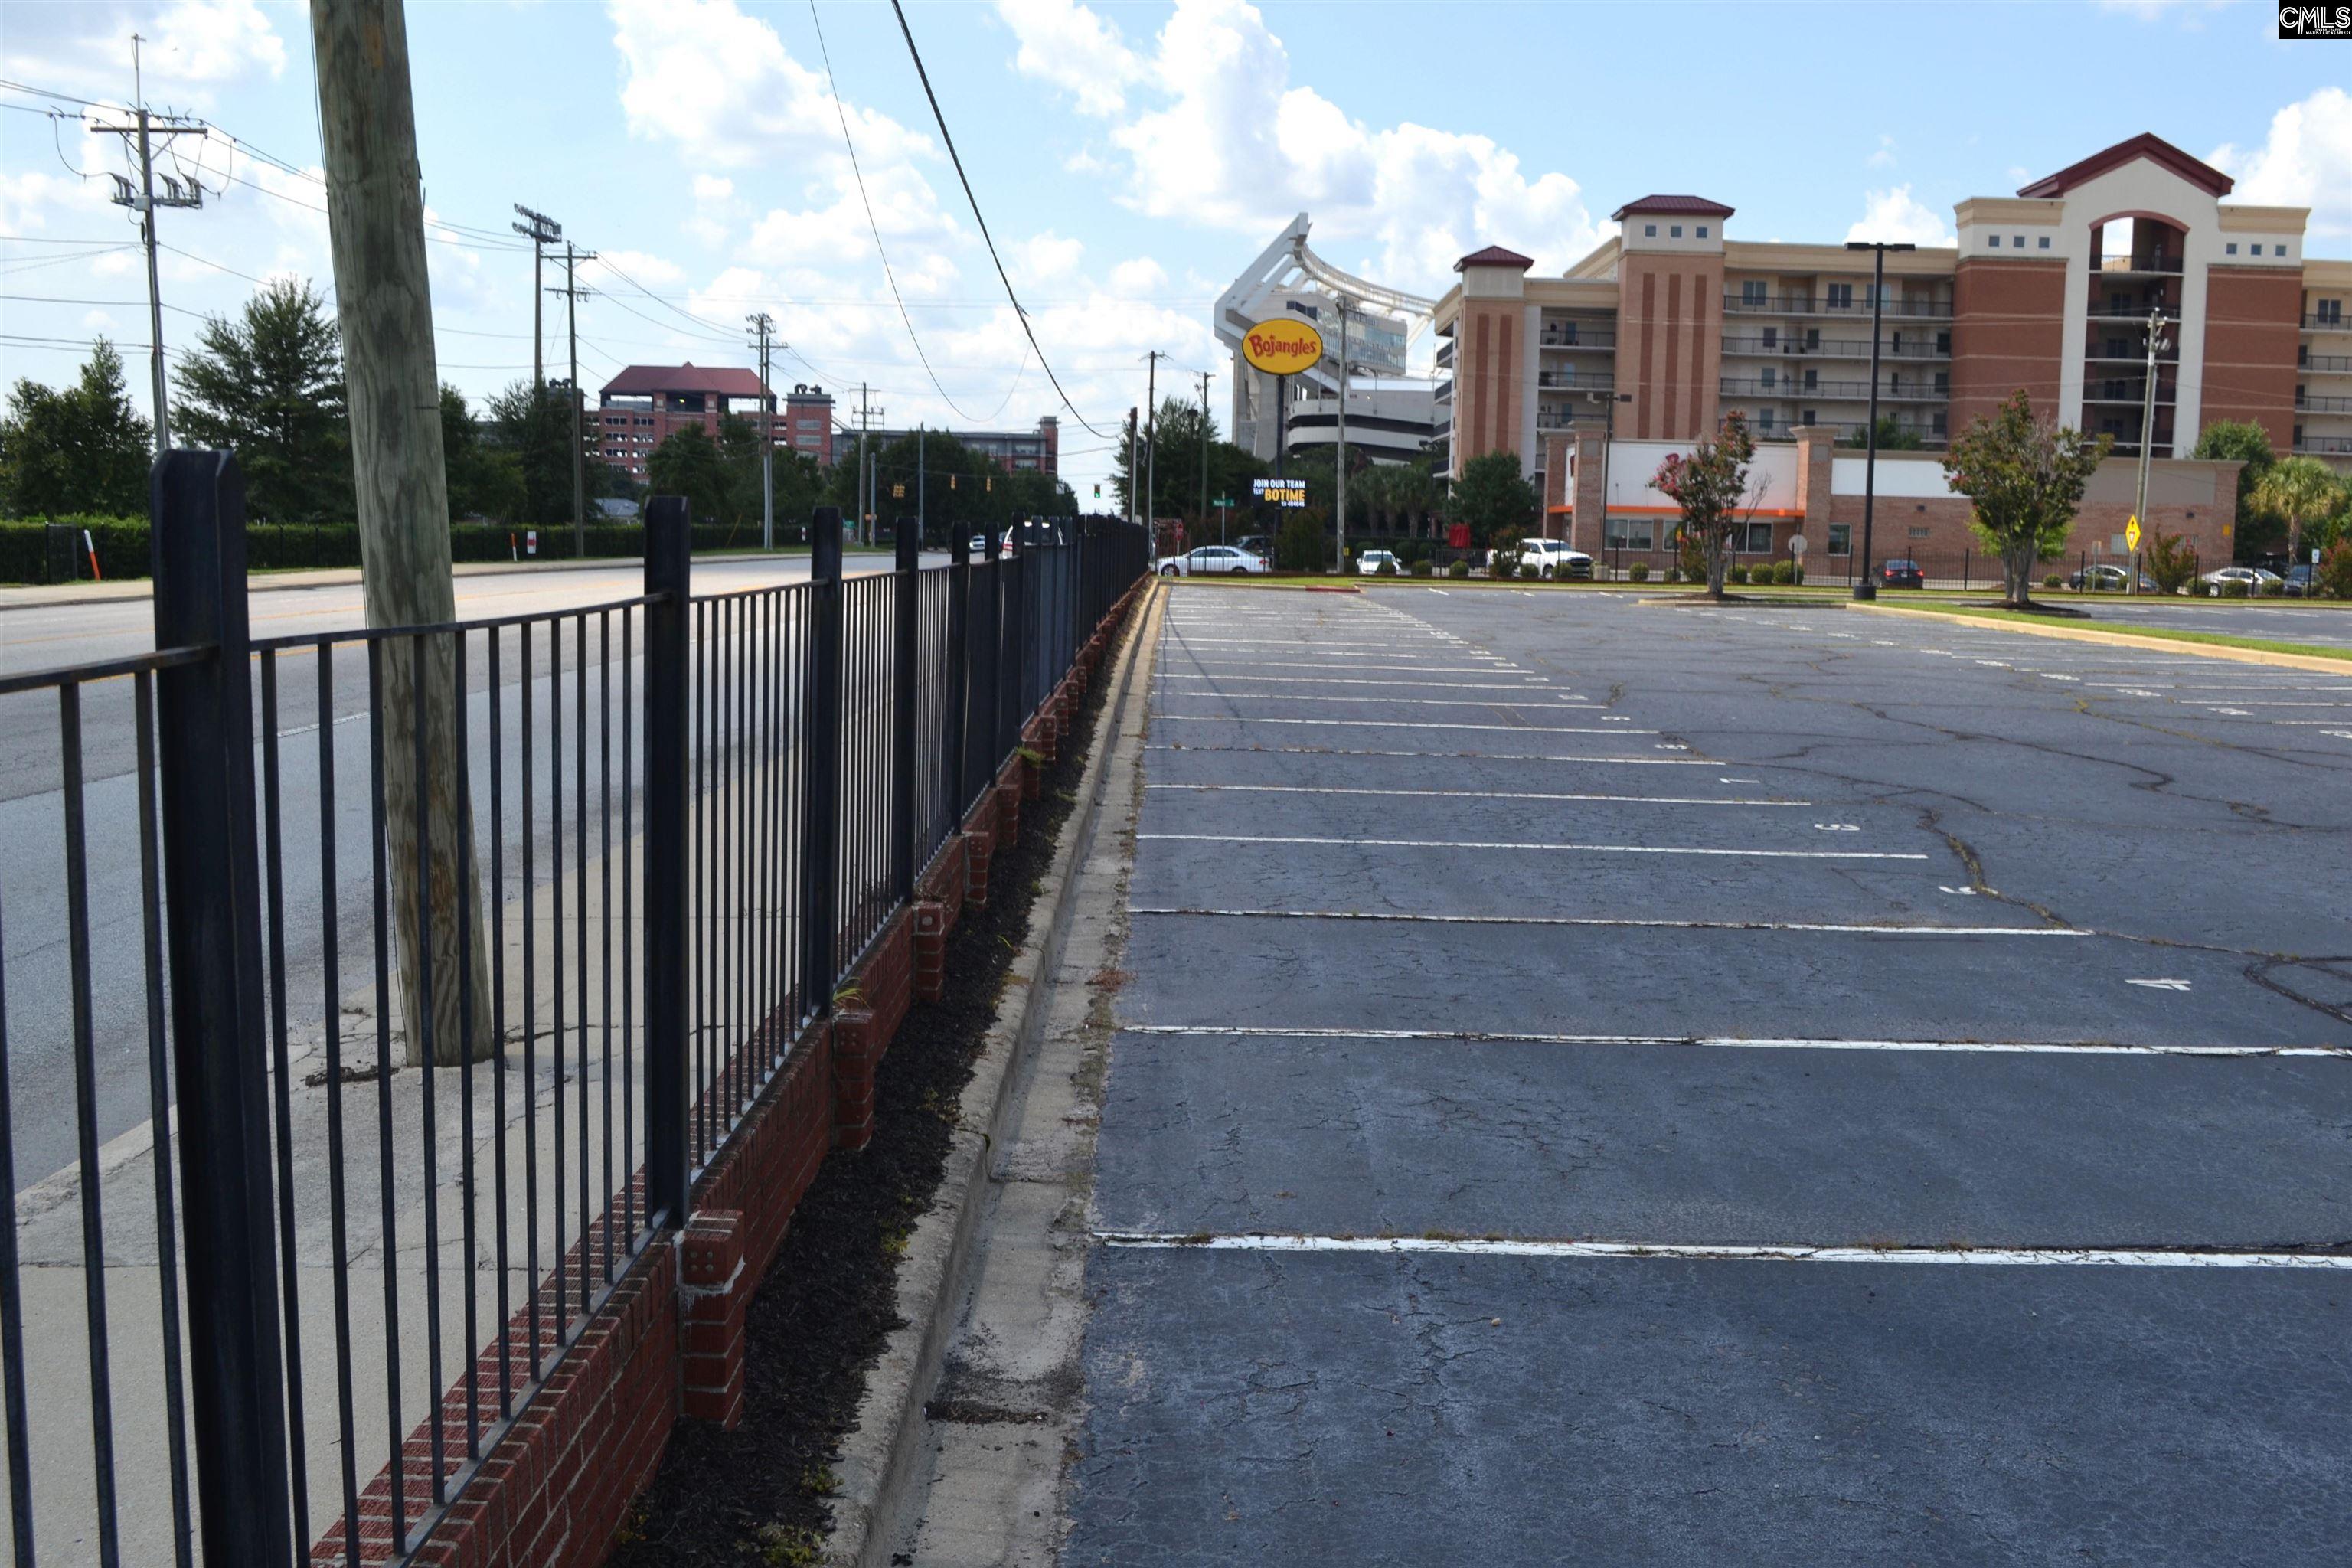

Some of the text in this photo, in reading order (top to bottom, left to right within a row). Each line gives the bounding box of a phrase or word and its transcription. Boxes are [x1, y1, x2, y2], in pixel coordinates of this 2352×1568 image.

[1249, 333, 1317, 358] Bojangles
[1253, 479, 1305, 488] JOIN OUR TEAM
[1265, 488, 1305, 501] BOTIME
[2125, 978, 2192, 991] 4
